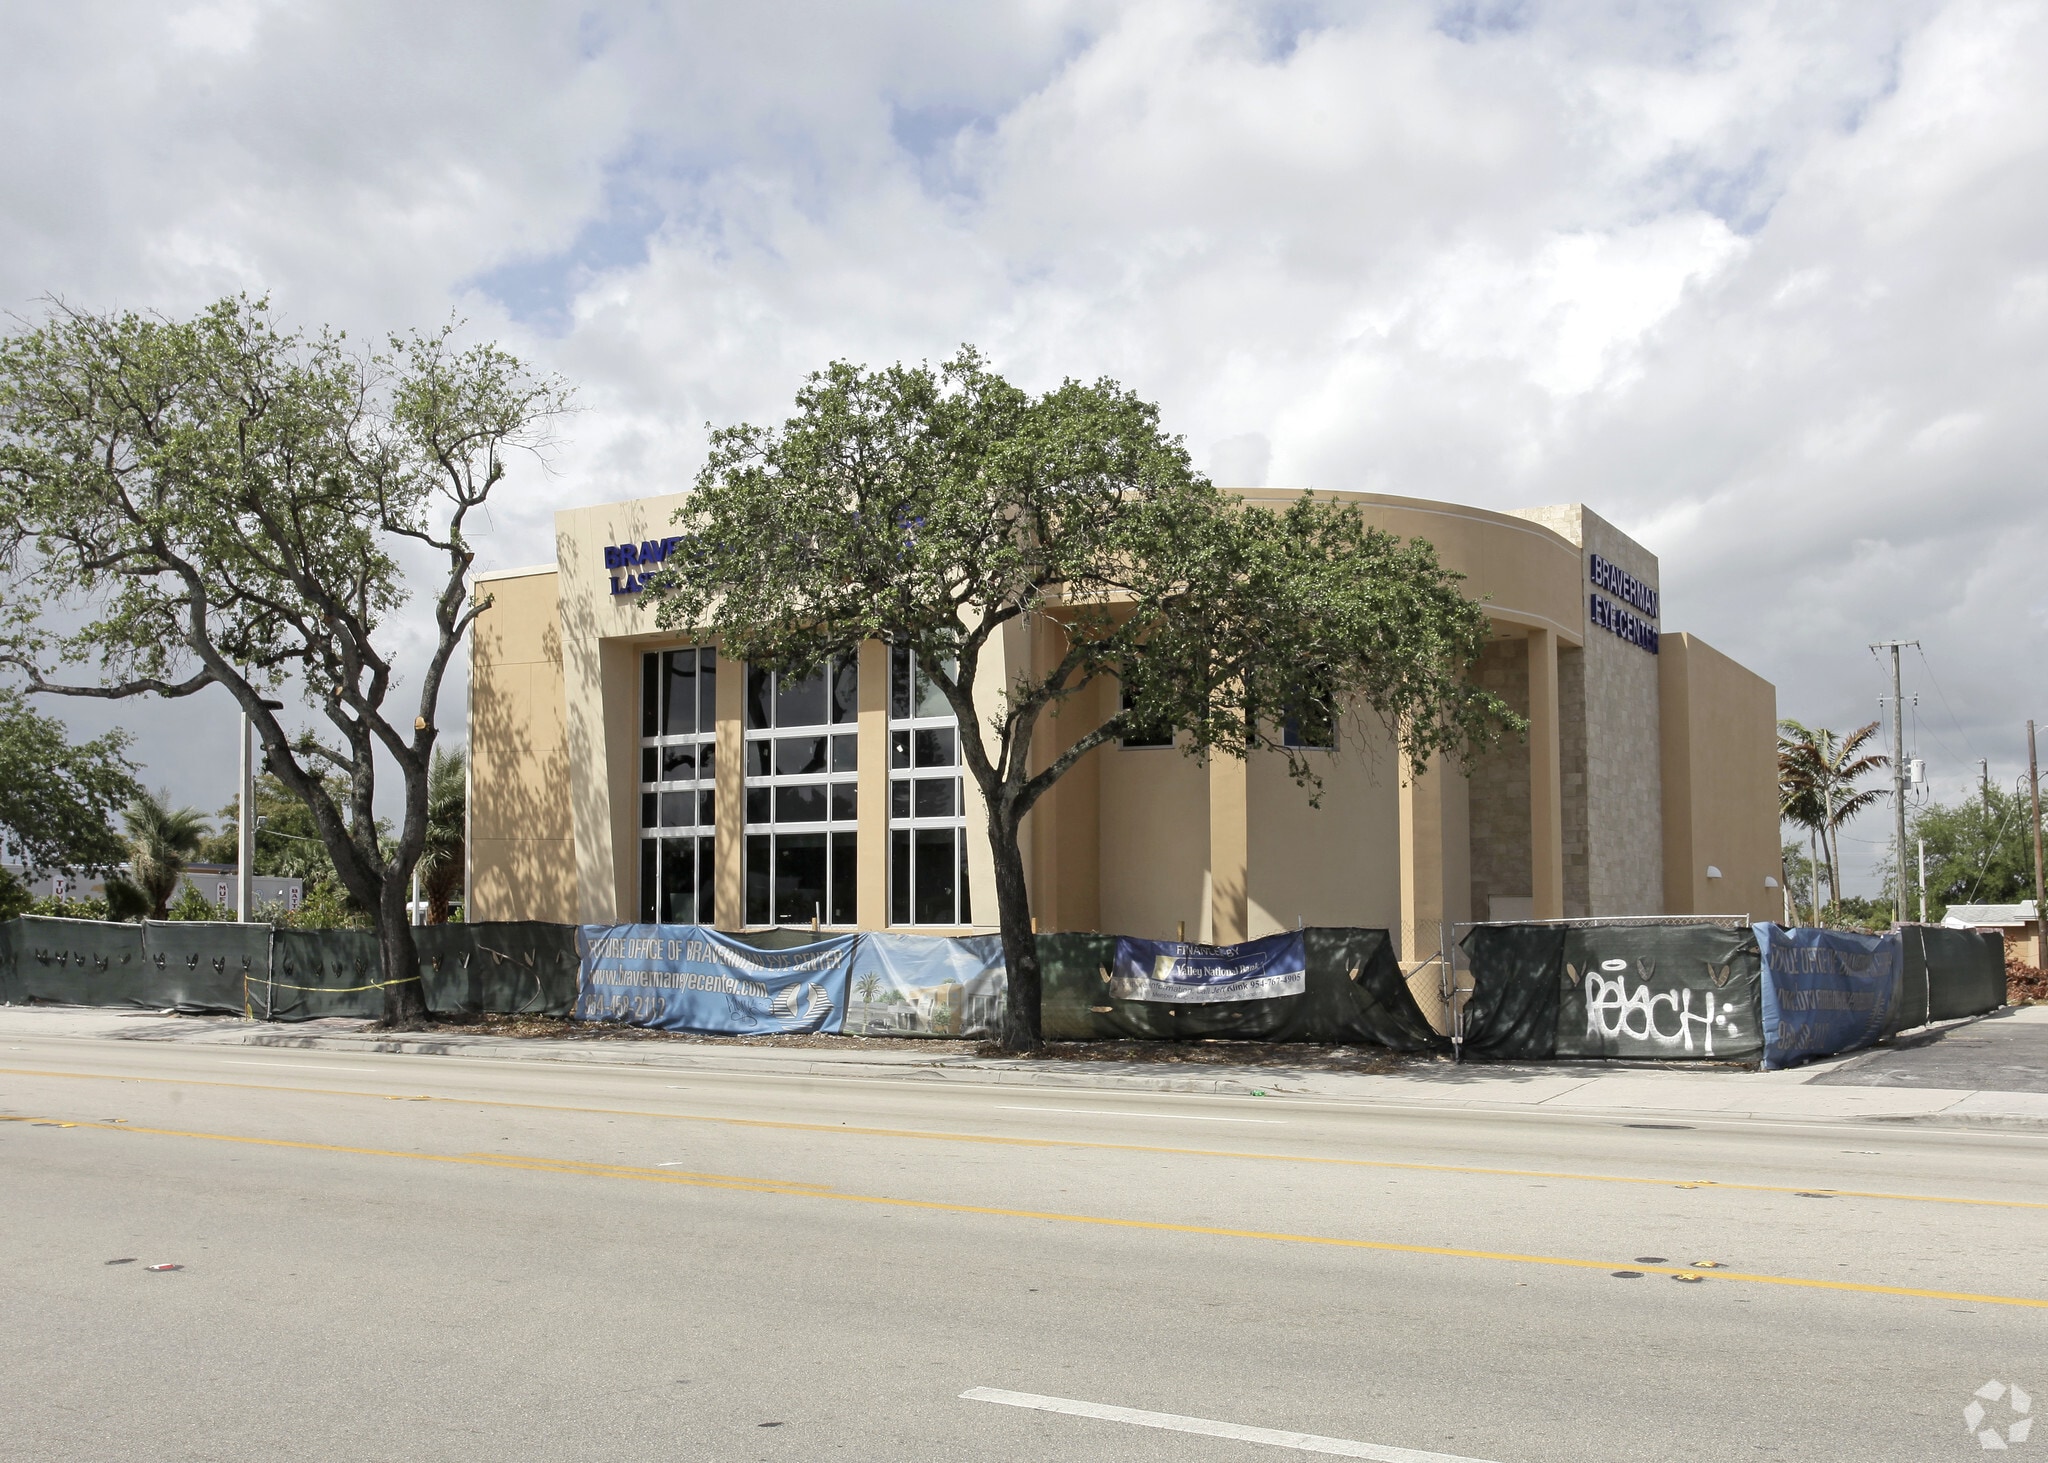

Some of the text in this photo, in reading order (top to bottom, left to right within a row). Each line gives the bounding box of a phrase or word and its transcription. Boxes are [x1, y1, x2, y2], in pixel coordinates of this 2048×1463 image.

[604, 536, 687, 569] BRAVE
[1591, 554, 1658, 618] BRAVERMAN
[1591, 594, 1658, 654] EYE CENTER
[628, 939, 663, 960] OFFICE
[667, 940, 683, 960] OF
[686, 941, 765, 971] BRAVERMAN
[765, 954, 791, 972] EYE
[792, 948, 843, 972] CENTER
[1226, 946, 1239, 957] BY
[590, 964, 768, 998] www.bravermaneyecenter.com
[1176, 962, 1260, 978] Valley National Bank
[1250, 973, 1301, 988] 954-767-4905
[585, 994, 665, 1018] 954-458-2112
